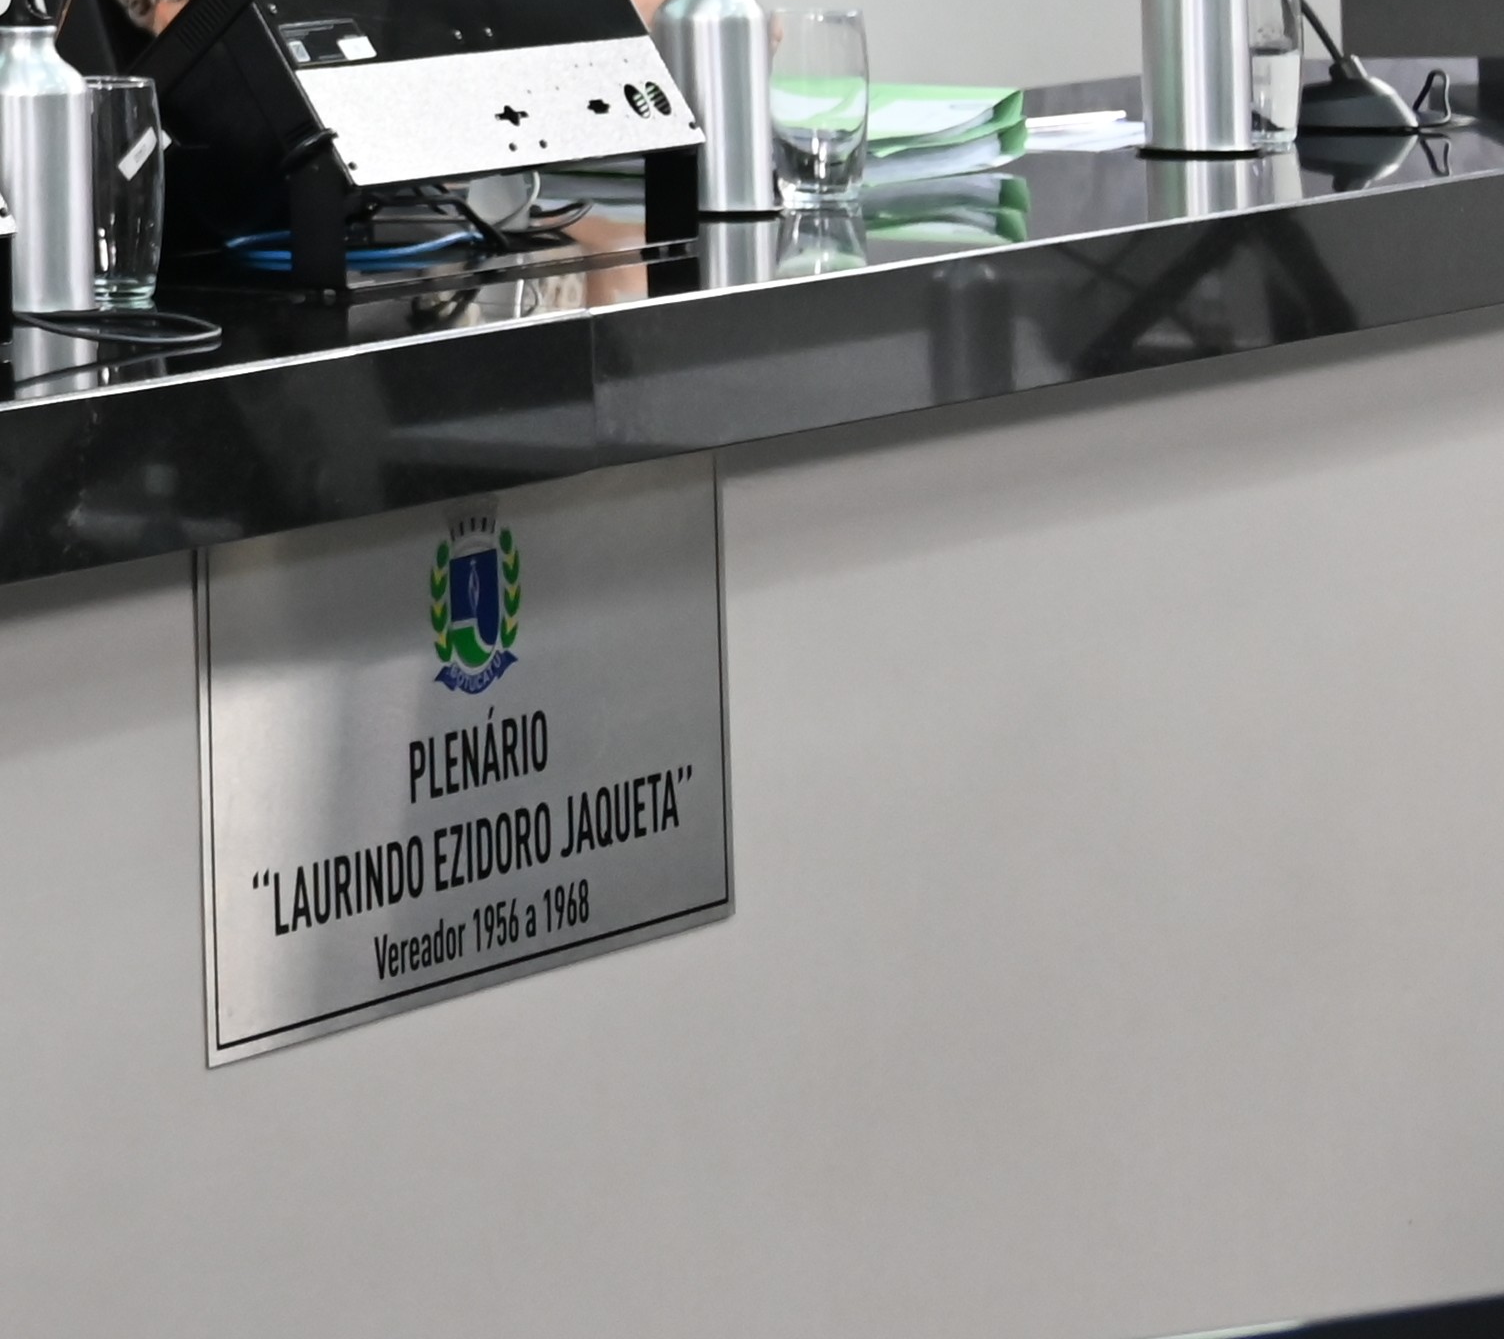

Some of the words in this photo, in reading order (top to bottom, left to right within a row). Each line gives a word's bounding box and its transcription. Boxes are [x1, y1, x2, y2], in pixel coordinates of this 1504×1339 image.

[409, 706, 549, 804] PLENÁRIO
[434, 801, 552, 893] EZIDORO
[374, 919, 466, 981] Vereador
[472, 899, 521, 953] 1956
[526, 907, 538, 938] a
[544, 877, 590, 931] 1968
